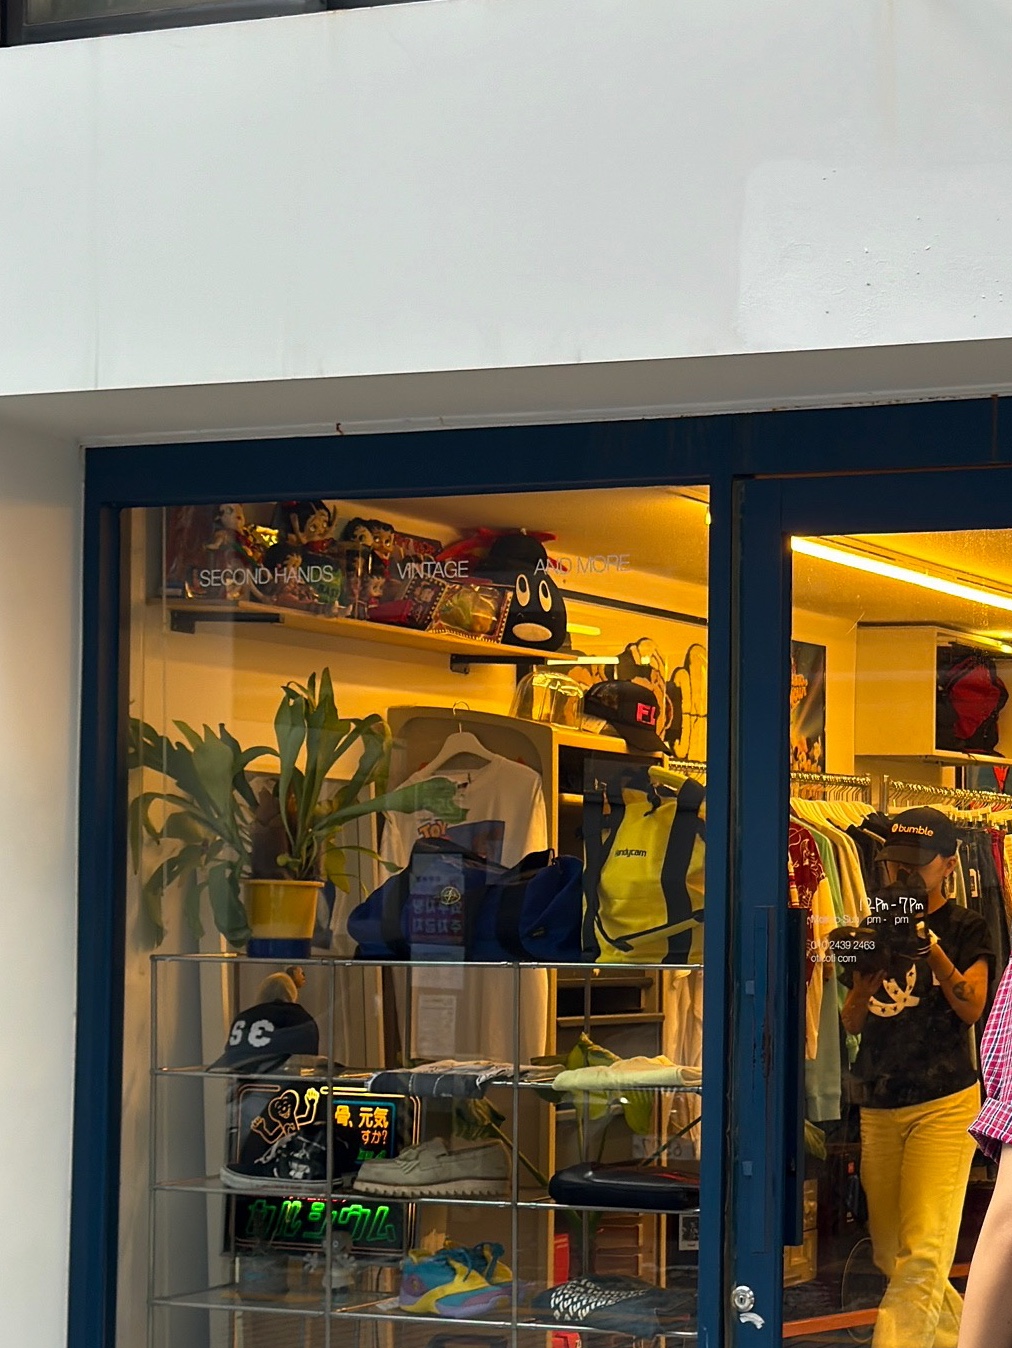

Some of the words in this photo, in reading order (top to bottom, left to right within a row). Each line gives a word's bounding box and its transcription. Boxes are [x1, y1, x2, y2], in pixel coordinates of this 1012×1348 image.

[397, 560, 469, 579] VINTAGE
[534, 556, 572, 576] AND
[576, 554, 631, 574] MORE
[200, 567, 272, 588] SECOND
[274, 564, 334, 584] HANDS
[898, 823, 934, 837] bumble
[829, 940, 851, 951] 2439
[853, 940, 876, 951] 2463
